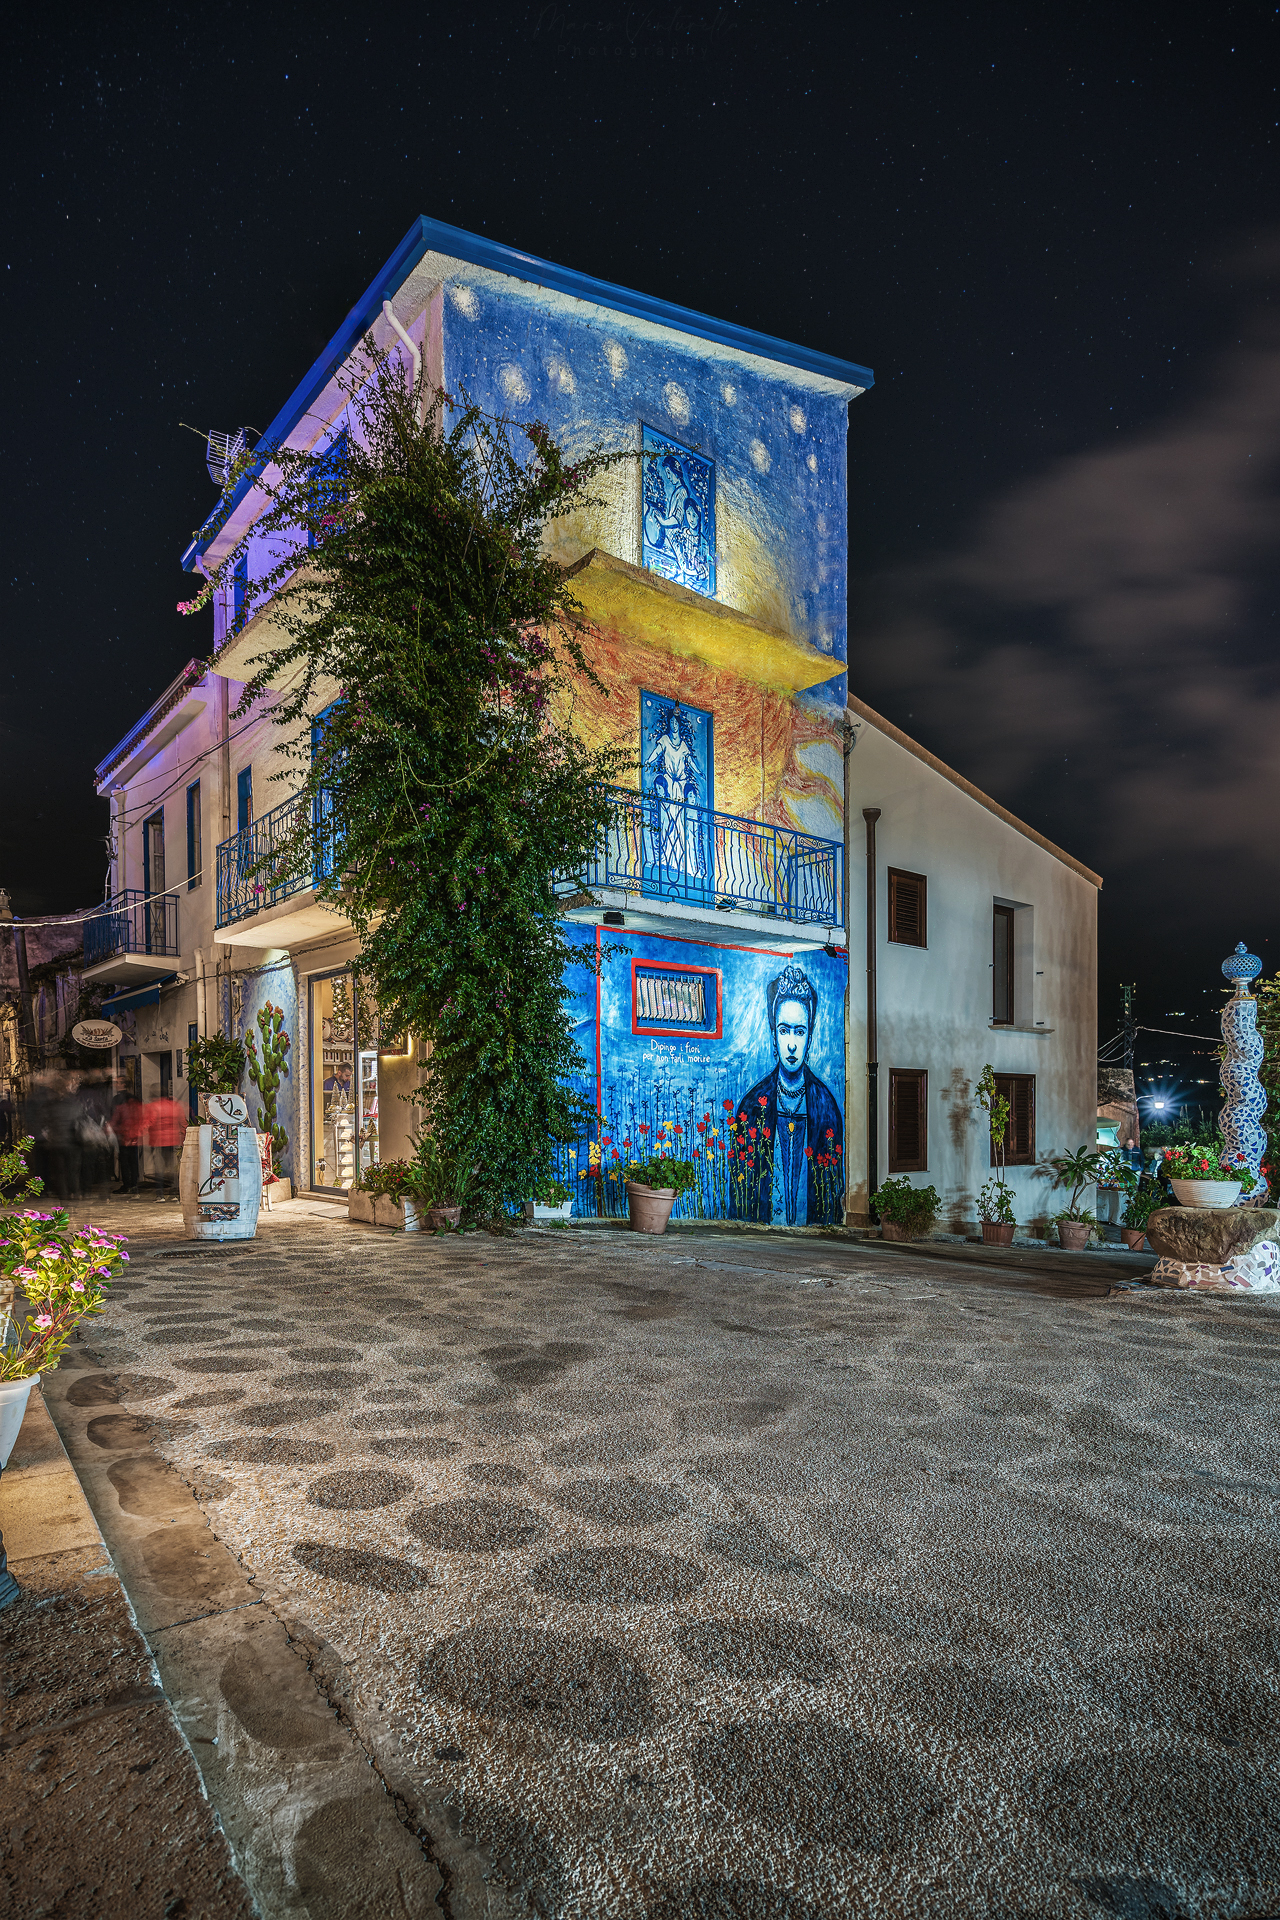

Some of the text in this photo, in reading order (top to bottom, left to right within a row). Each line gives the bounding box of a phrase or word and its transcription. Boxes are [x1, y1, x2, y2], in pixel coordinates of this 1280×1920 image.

[650, 1038, 677, 1055] Dipingo
[685, 1041, 700, 1053] fiori
[642, 1052, 711, 1064] per non farli morire
